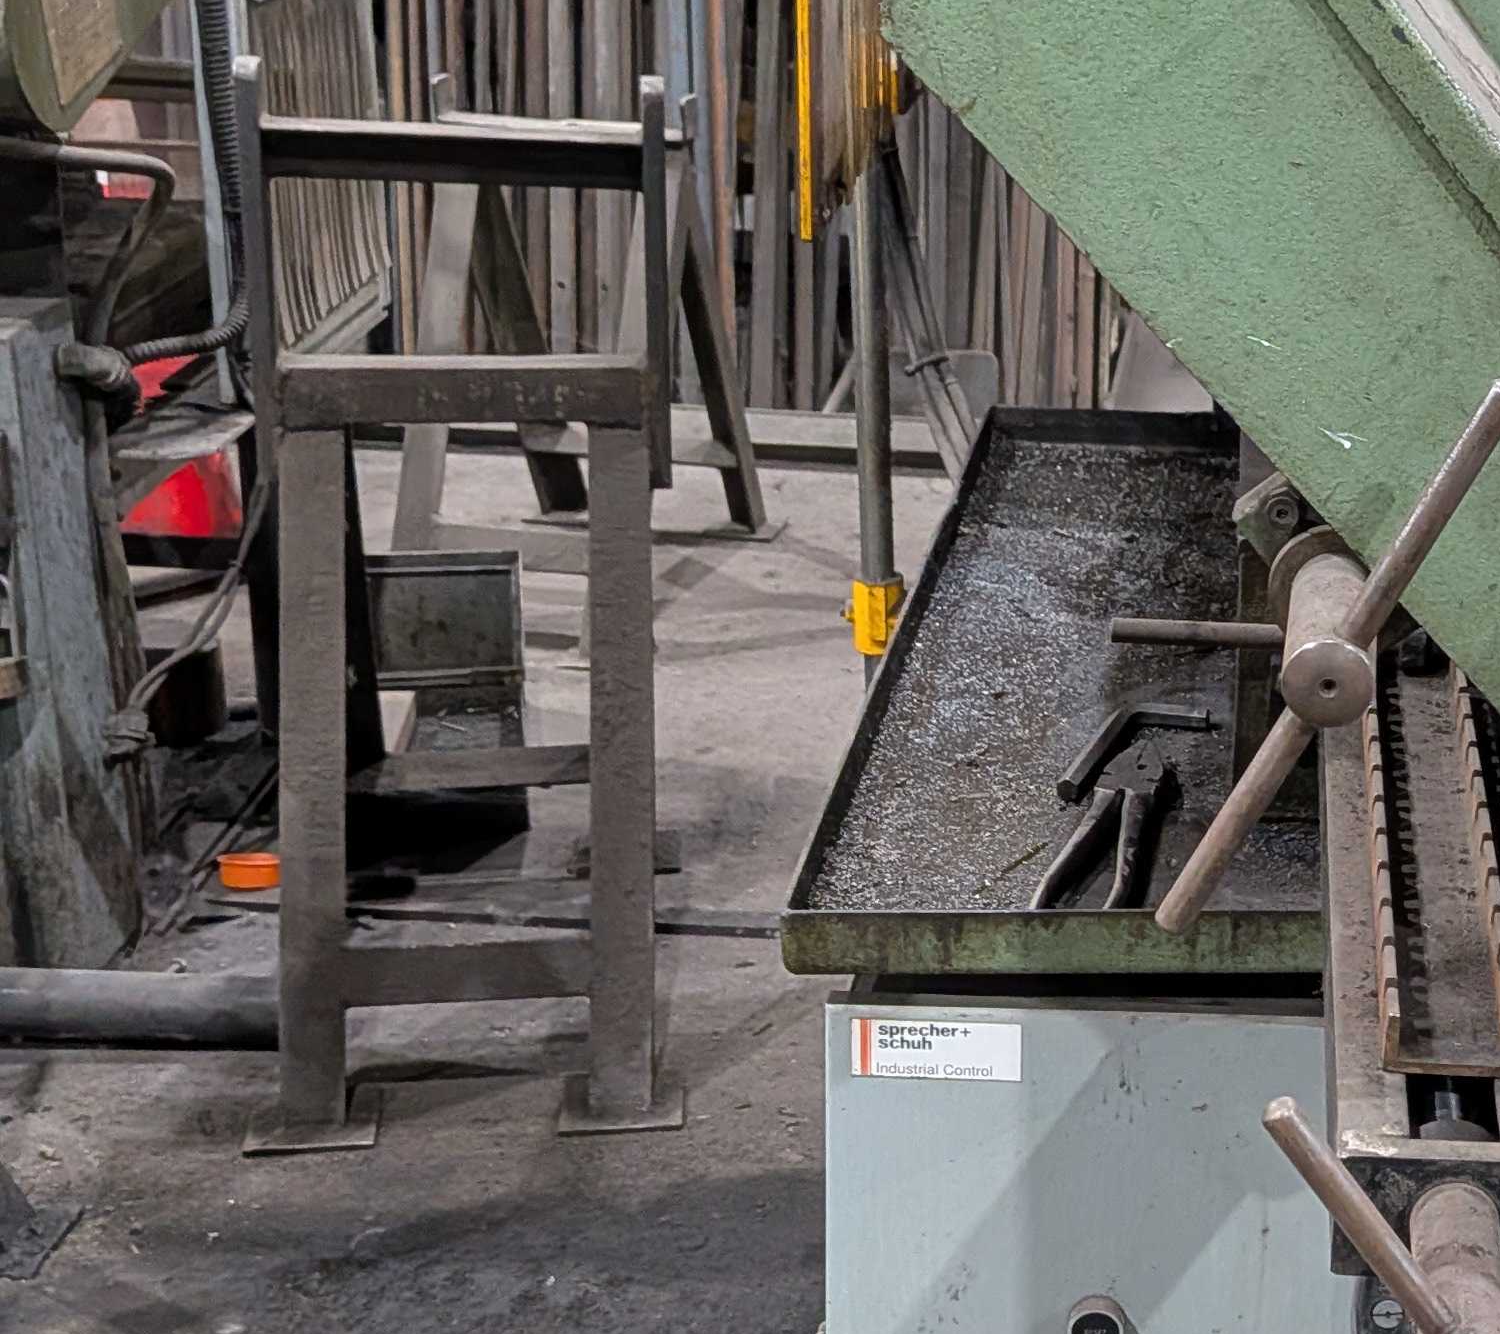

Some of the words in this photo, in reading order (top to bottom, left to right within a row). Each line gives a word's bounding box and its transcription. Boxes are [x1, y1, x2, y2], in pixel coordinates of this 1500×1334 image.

[878, 1023, 971, 1038] sprecher+
[878, 1037, 933, 1050] schuh
[876, 1062, 939, 1075] Industrial
[943, 1063, 993, 1077] Control
